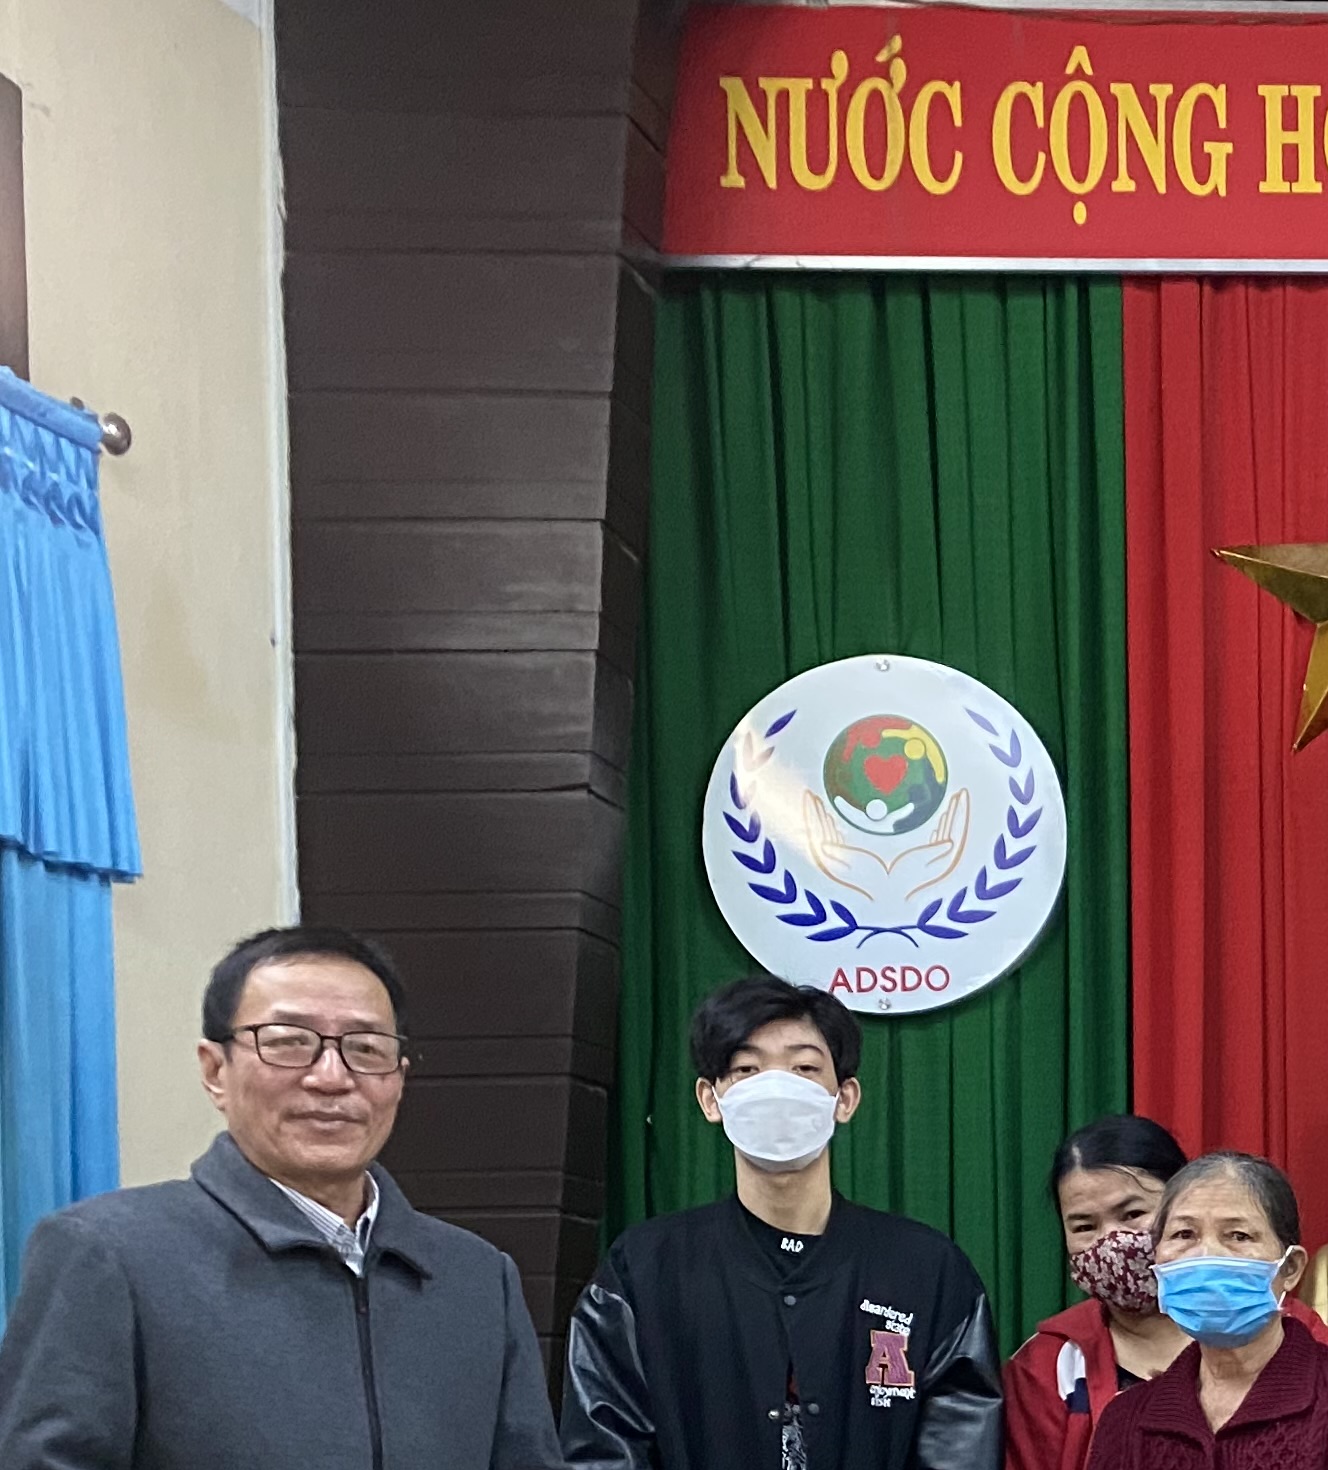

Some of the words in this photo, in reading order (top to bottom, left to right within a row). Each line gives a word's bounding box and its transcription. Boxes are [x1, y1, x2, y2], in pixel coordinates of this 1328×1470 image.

[719, 36, 963, 196] NƯỚC
[991, 45, 1234, 226] CỘNG
[828, 964, 951, 995] ADSDO
[780, 1237, 804, 1253] BAD
[865, 1329, 915, 1387] A
